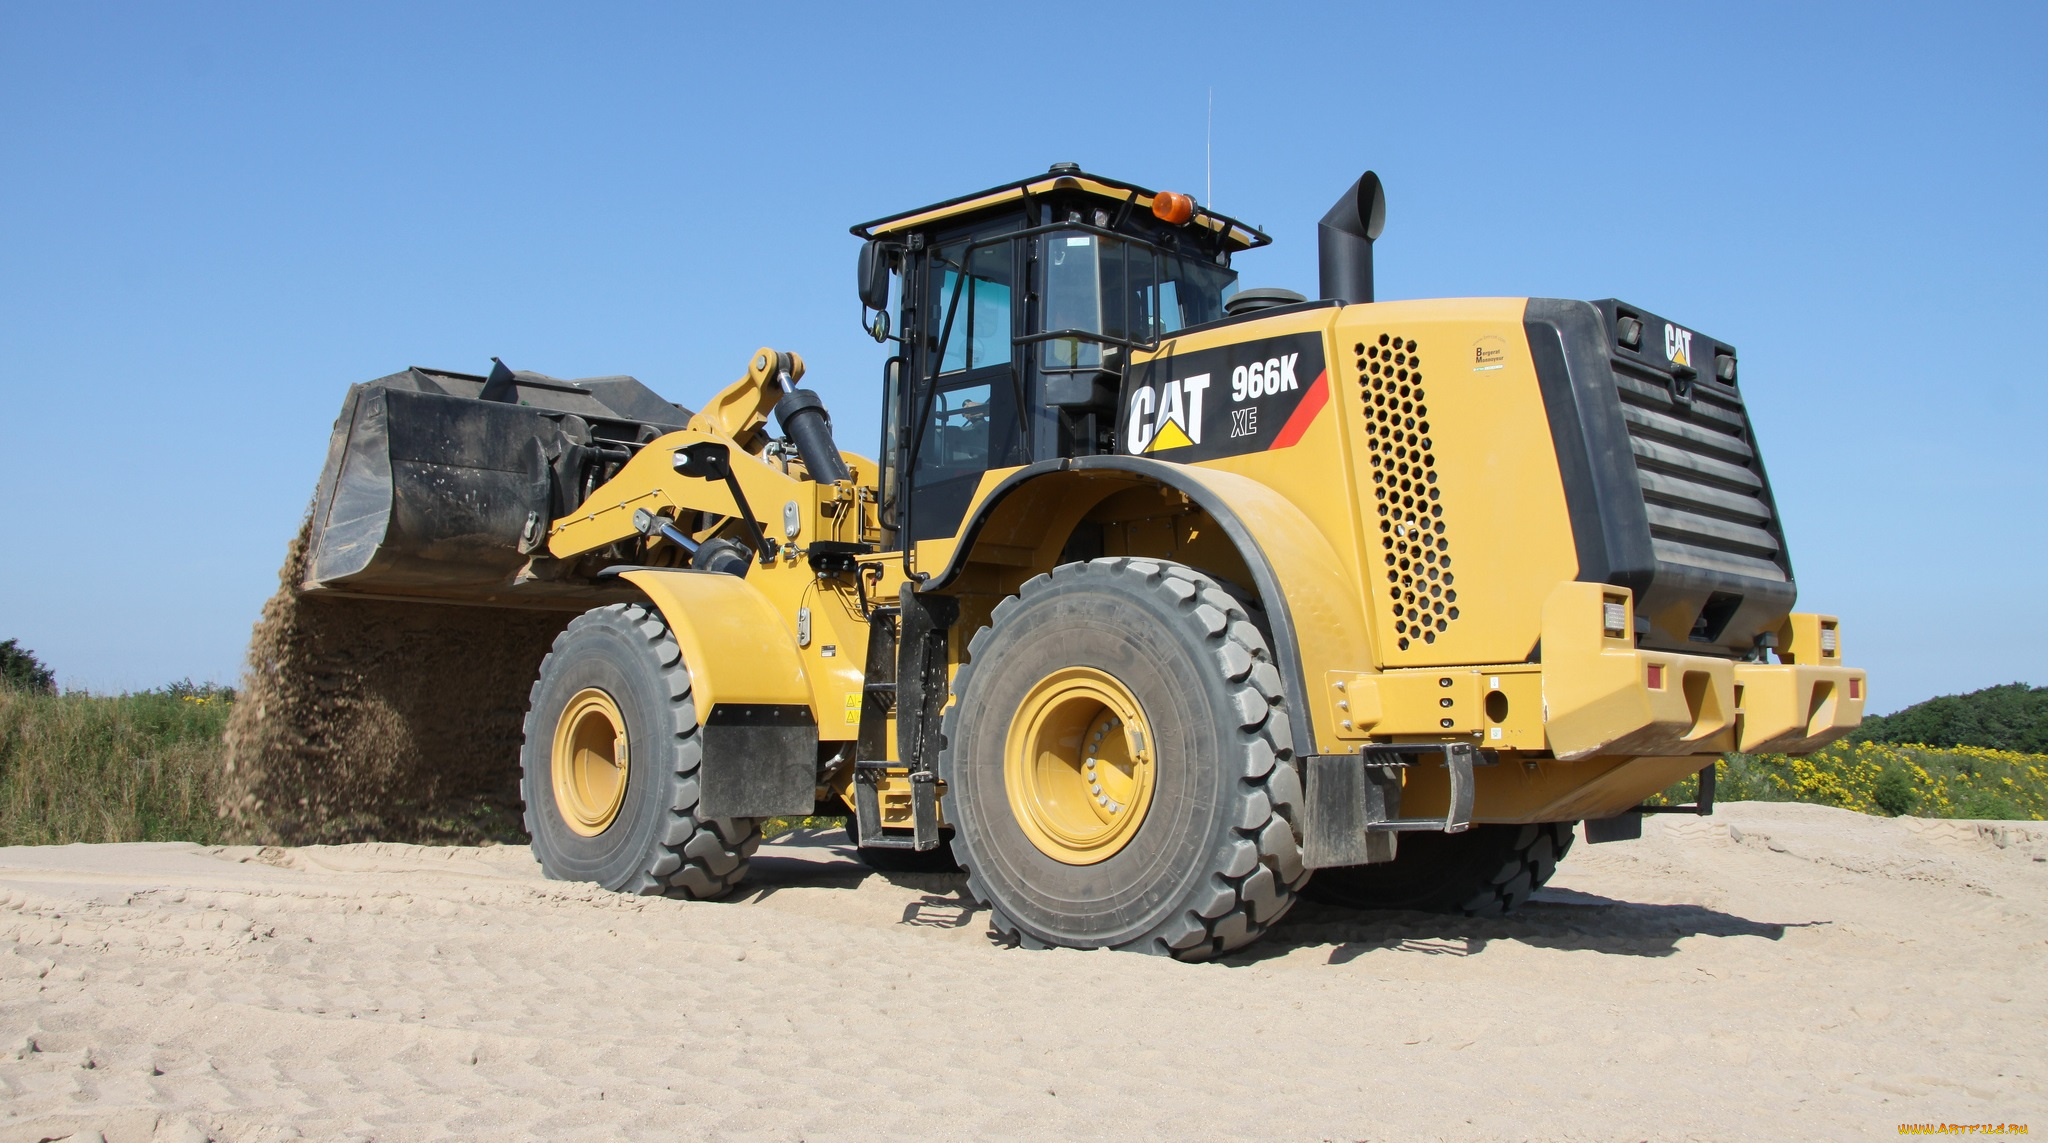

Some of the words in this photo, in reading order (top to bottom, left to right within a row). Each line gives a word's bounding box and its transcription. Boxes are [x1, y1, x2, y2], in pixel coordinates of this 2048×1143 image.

[1664, 323, 1692, 367] CAT
[1232, 353, 1299, 402] 966K
[1127, 373, 1211, 455] CAT
[1231, 407, 1257, 438] XE
